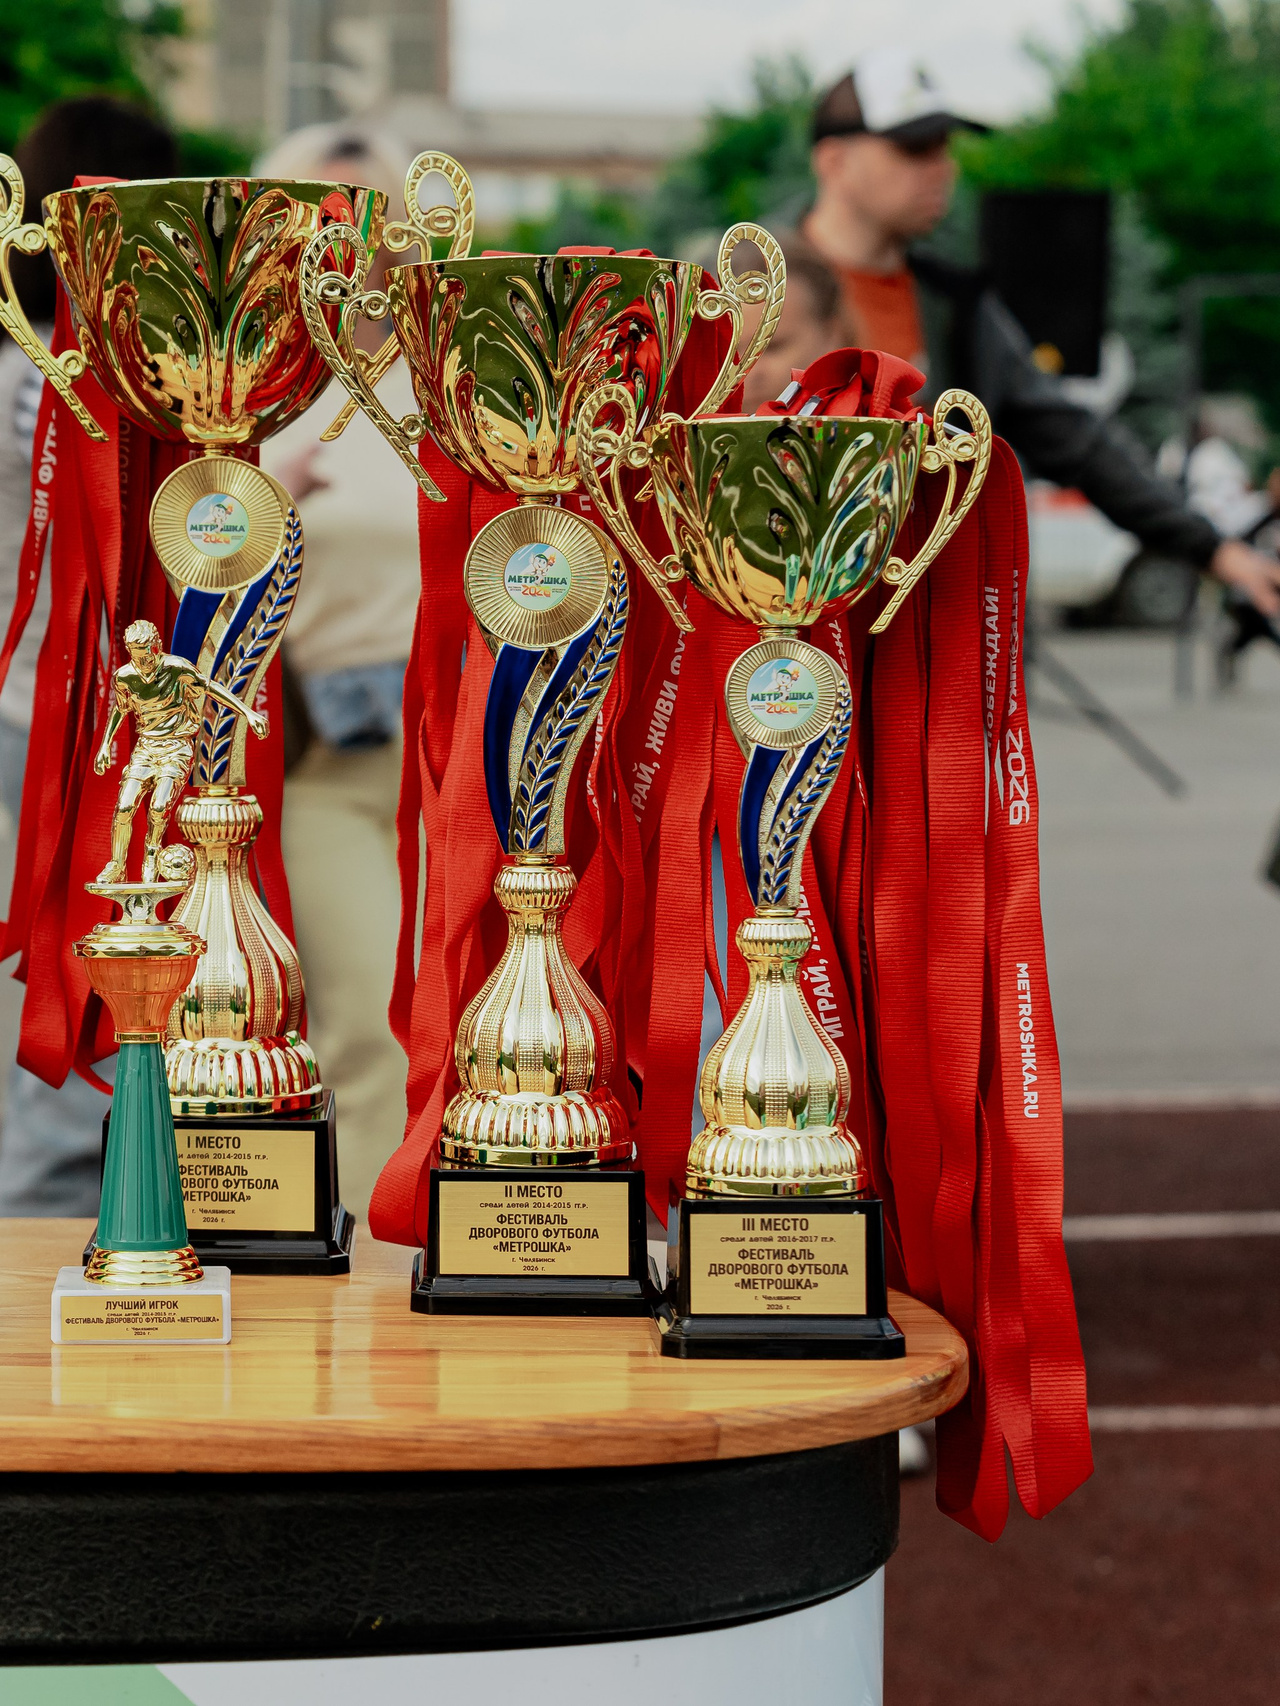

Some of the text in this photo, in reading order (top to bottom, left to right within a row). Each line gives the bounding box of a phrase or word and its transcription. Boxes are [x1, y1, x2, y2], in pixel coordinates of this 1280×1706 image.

[645, 680, 679, 755] ЖИВИ
[1016, 962, 1040, 1119] METROSHKA.RU
[196, 1136, 241, 1149] МЕСТО
[181, 1178, 279, 1190] ОВОГО ФУТБОЛА
[505, 1185, 563, 1198] II МЕСТО
[496, 1214, 568, 1225] ФЕСТИВАЛЬ
[742, 1218, 809, 1231] III МЕСТО
[469, 1227, 599, 1240] ДВОРОВОГО ФУТБОЛА
[493, 1242, 571, 1253] «МЕТРОШКА»
[738, 1249, 815, 1260] ФЕСТИВАЛЬ
[708, 1264, 849, 1277] ДВОРОВОГО ФУТБОЛА
[734, 1279, 819, 1290] «МЕТРОШКА»
[105, 1299, 179, 1310] ЛУЧШИЙ ИГРОК
[65, 1317, 104, 1325] ФЕСТИВАЛЬ
[105, 1317, 143, 1325] ДВОРОВОГО
